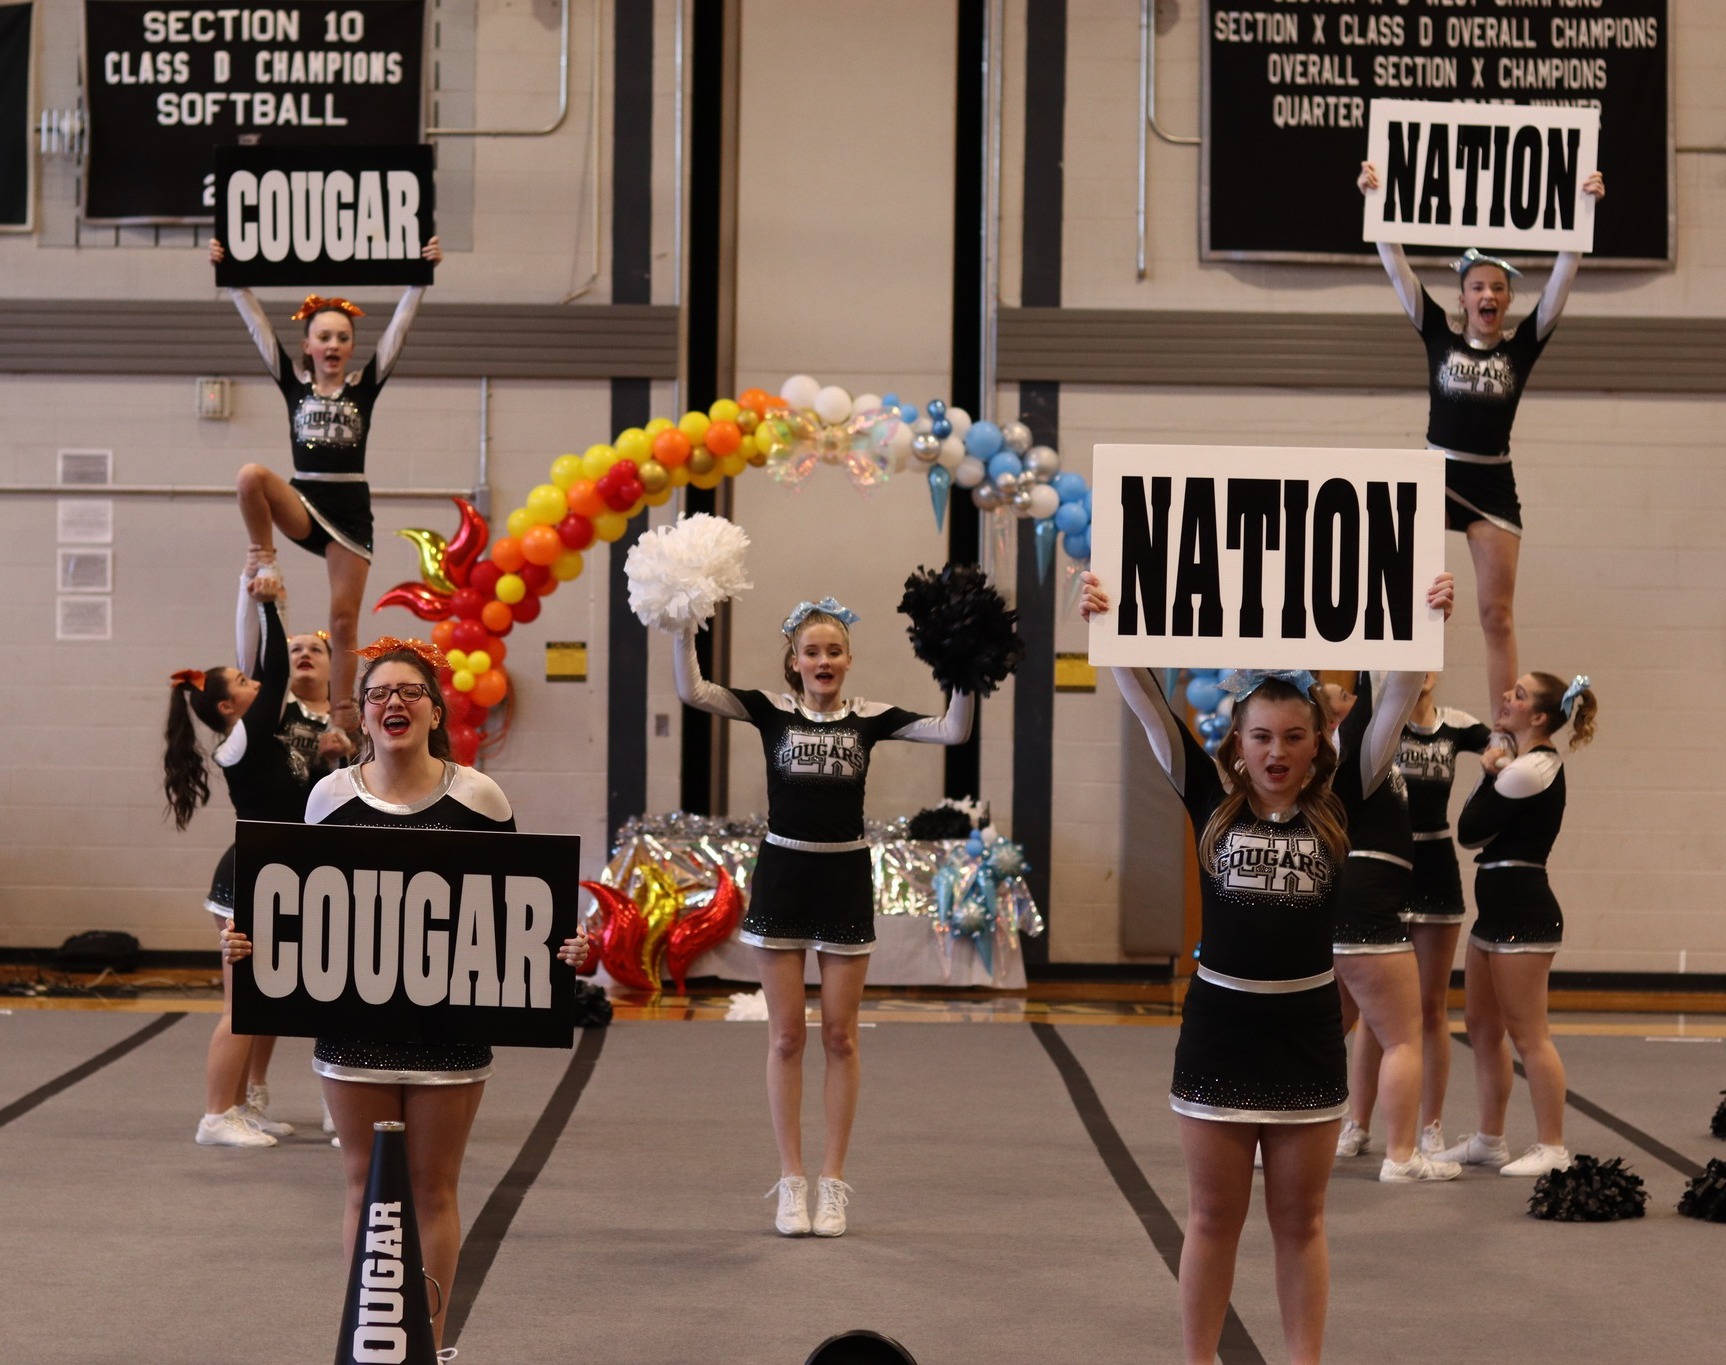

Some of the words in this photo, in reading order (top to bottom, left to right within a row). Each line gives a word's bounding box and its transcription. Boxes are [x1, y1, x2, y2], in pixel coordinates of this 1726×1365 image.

[143, 9, 300, 43] SECTION
[324, 10, 365, 43] 10
[1215, 11, 1299, 44] SECTION
[1312, 13, 1326, 46] X
[1339, 14, 1405, 47] CLASS
[1419, 16, 1433, 47] D
[1446, 16, 1537, 49] OVERALL
[1551, 16, 1658, 49] CHAMPIONS
[104, 51, 190, 84] CLASS
[213, 50, 231, 84] D
[255, 50, 403, 84] CHAMPIONS
[1268, 53, 1360, 86] OVERALL
[1373, 55, 1457, 89] SECTION
[1471, 56, 1485, 89] X
[1498, 57, 1607, 90] CHAMPIONS
[157, 92, 348, 126] SOFTBALL
[1273, 94, 1365, 129] QUARTER
[1382, 120, 1582, 232] NATION
[227, 169, 421, 263] COUGAR
[1117, 475, 1418, 643] NATION
[781, 743, 864, 770] COUGARS
[1217, 848, 1328, 881] COUGARS
[252, 863, 554, 1009] COUGAR
[352, 1201, 407, 1365] OUGAR
